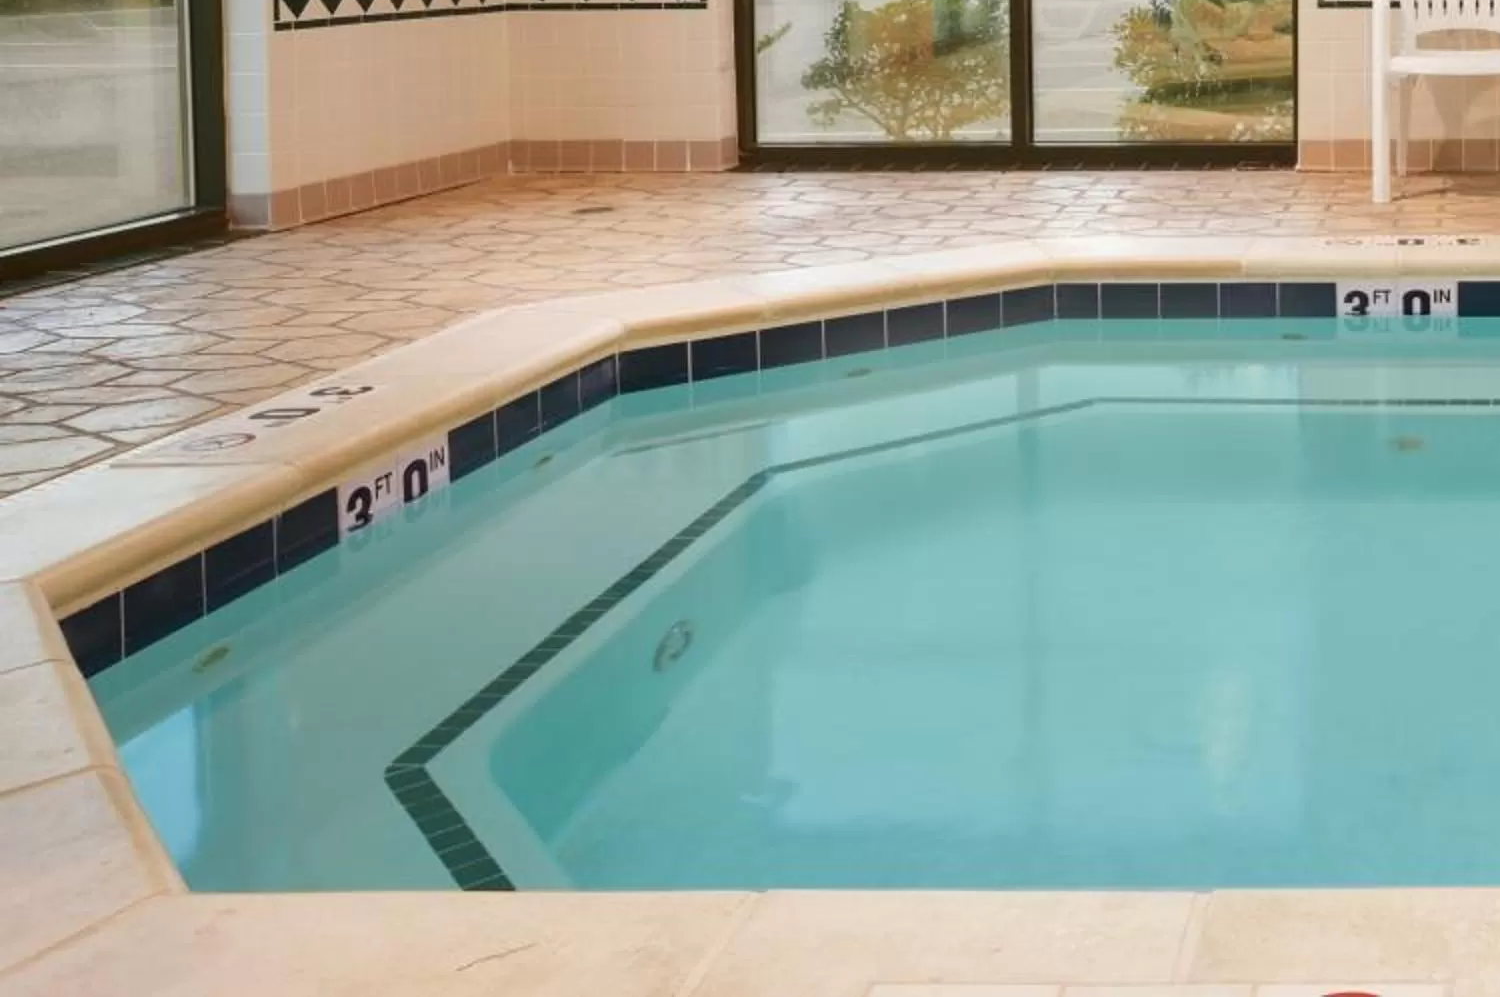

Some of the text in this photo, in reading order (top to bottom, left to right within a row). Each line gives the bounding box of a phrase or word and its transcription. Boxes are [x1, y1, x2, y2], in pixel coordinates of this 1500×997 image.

[1343, 289, 1451, 316] 3 FT 0 IN
[346, 443, 445, 533] 3 FT 0 IN
